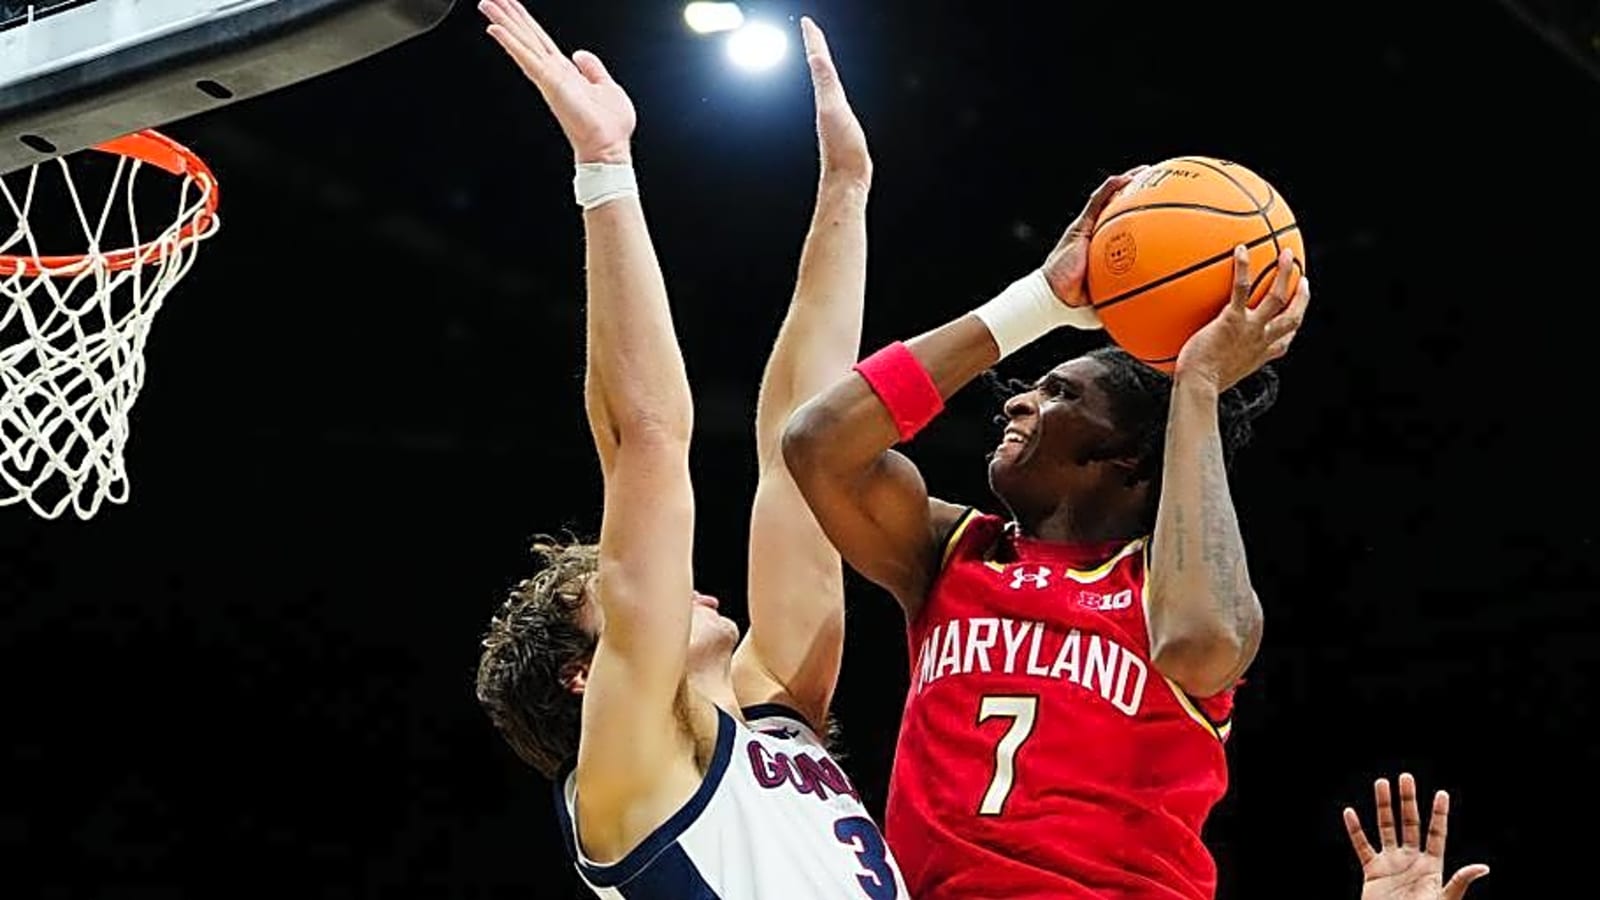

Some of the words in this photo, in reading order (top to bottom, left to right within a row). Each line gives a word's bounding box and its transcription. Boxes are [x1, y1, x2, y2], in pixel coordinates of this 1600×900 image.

[918, 617, 1149, 717] MARYLAND
[977, 694, 1040, 818] 7
[834, 816, 898, 900] 3
